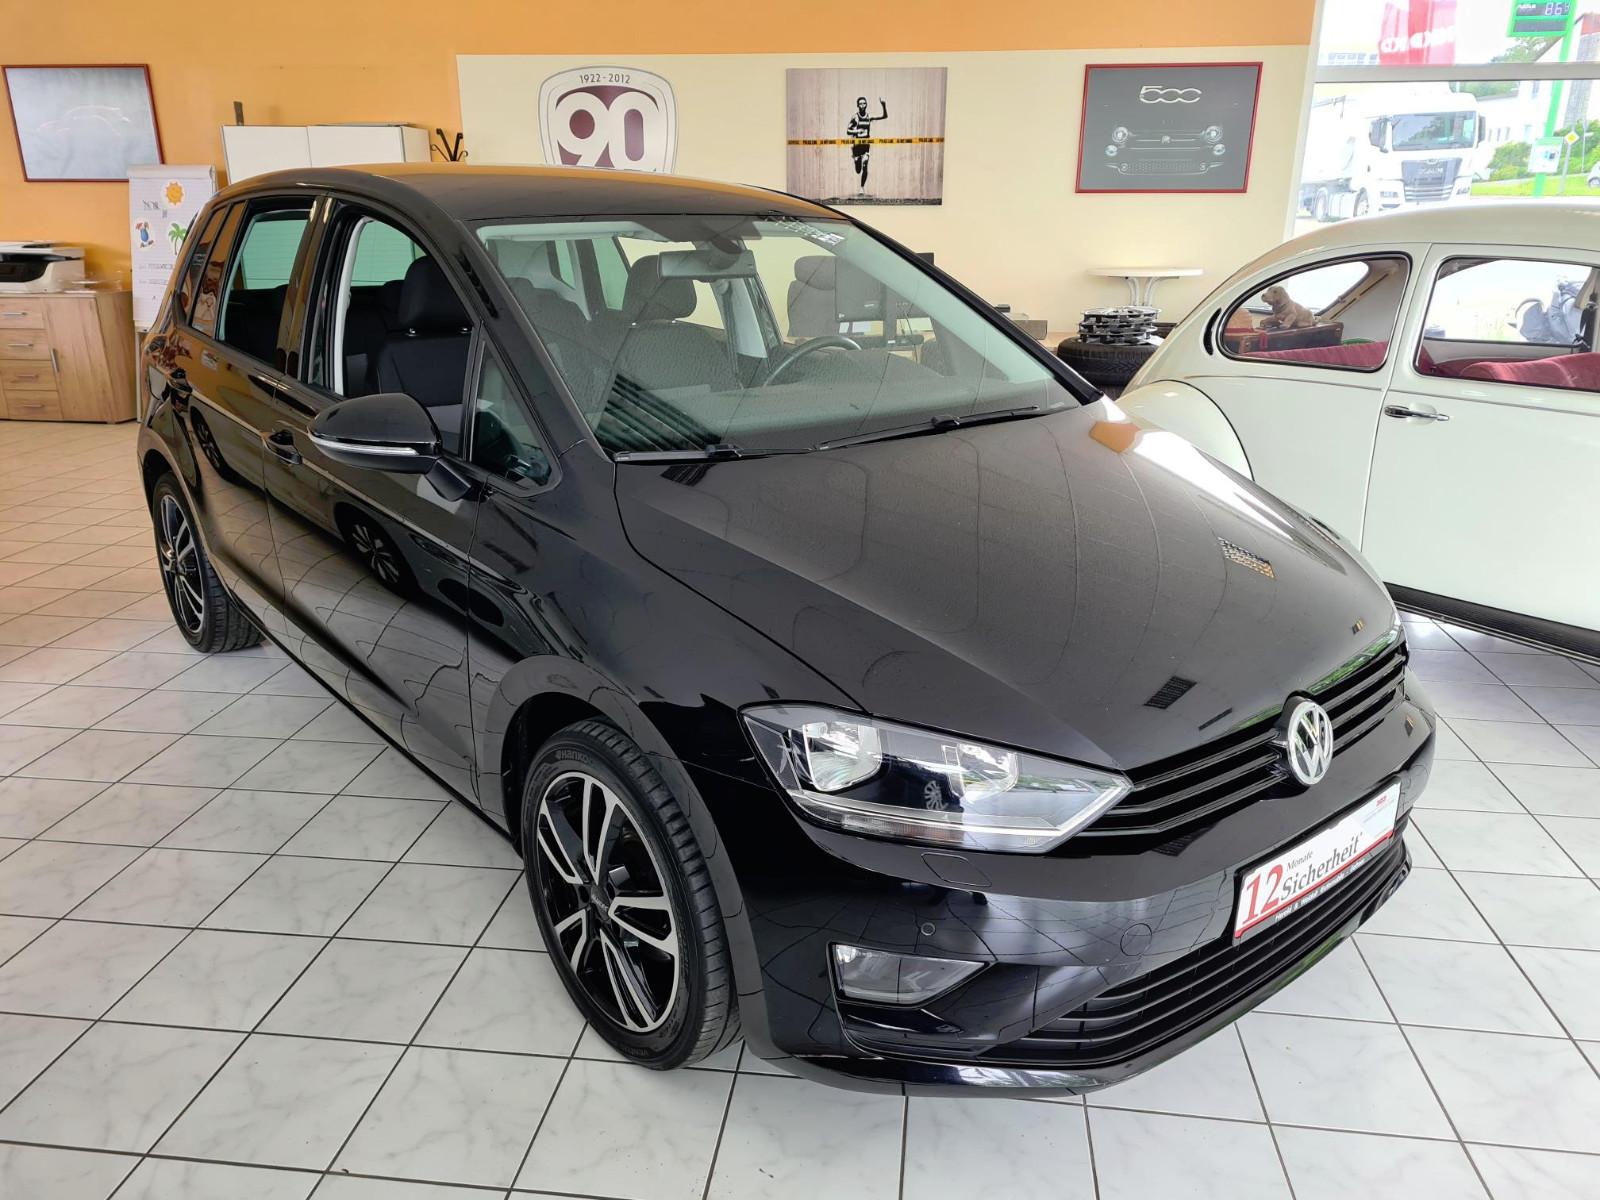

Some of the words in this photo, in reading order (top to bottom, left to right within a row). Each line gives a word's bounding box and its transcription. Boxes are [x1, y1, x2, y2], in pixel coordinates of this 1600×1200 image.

[1139, 85, 1202, 104] 500
[553, 91, 662, 169] 90
[1281, 838, 1360, 901] Sicherheit
[1287, 851, 1314, 871] Monate
[1242, 864, 1284, 924] 12
